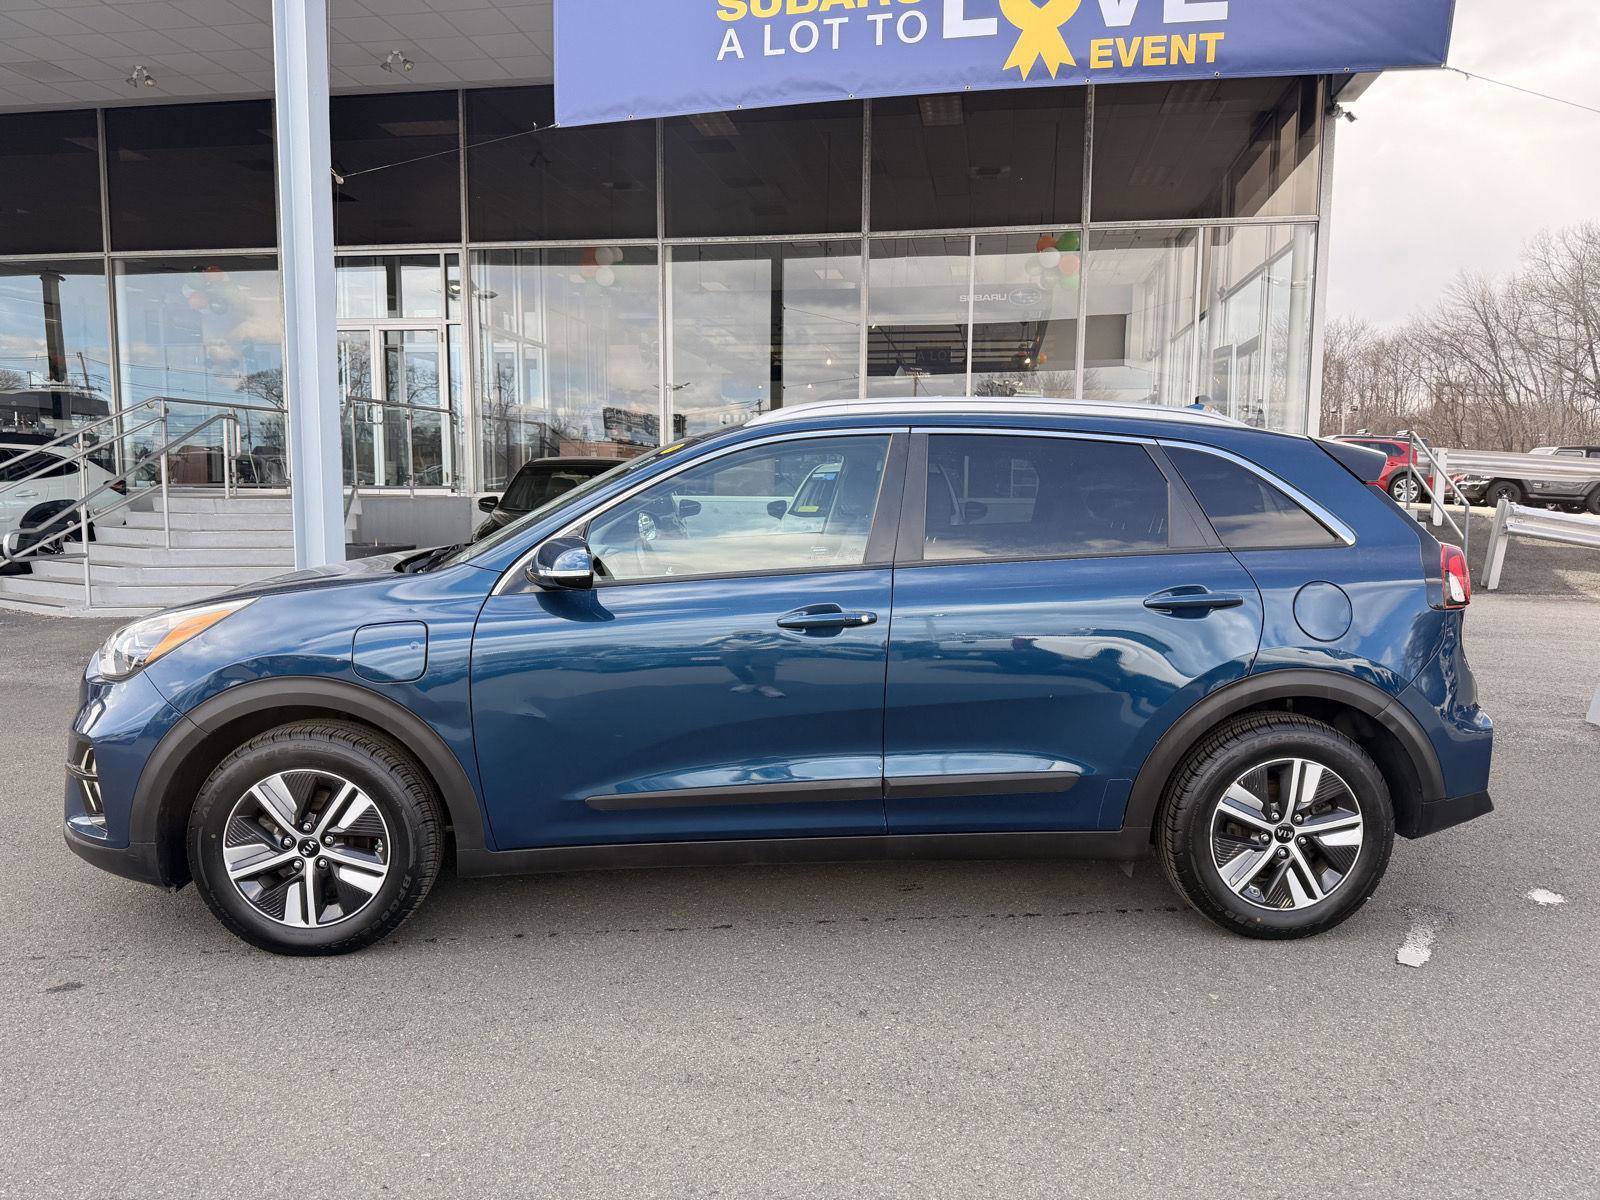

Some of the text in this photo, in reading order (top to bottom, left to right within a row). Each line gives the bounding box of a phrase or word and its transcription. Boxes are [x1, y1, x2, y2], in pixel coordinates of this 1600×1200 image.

[717, 0, 922, 21] SUB
[716, 28, 745, 61] A
[763, 17, 849, 56] LOT
[866, 10, 928, 46] TO
[1089, 32, 1225, 69] EVENT
[959, 293, 1007, 302] SBARU
[300, 841, 316, 856] KIA
